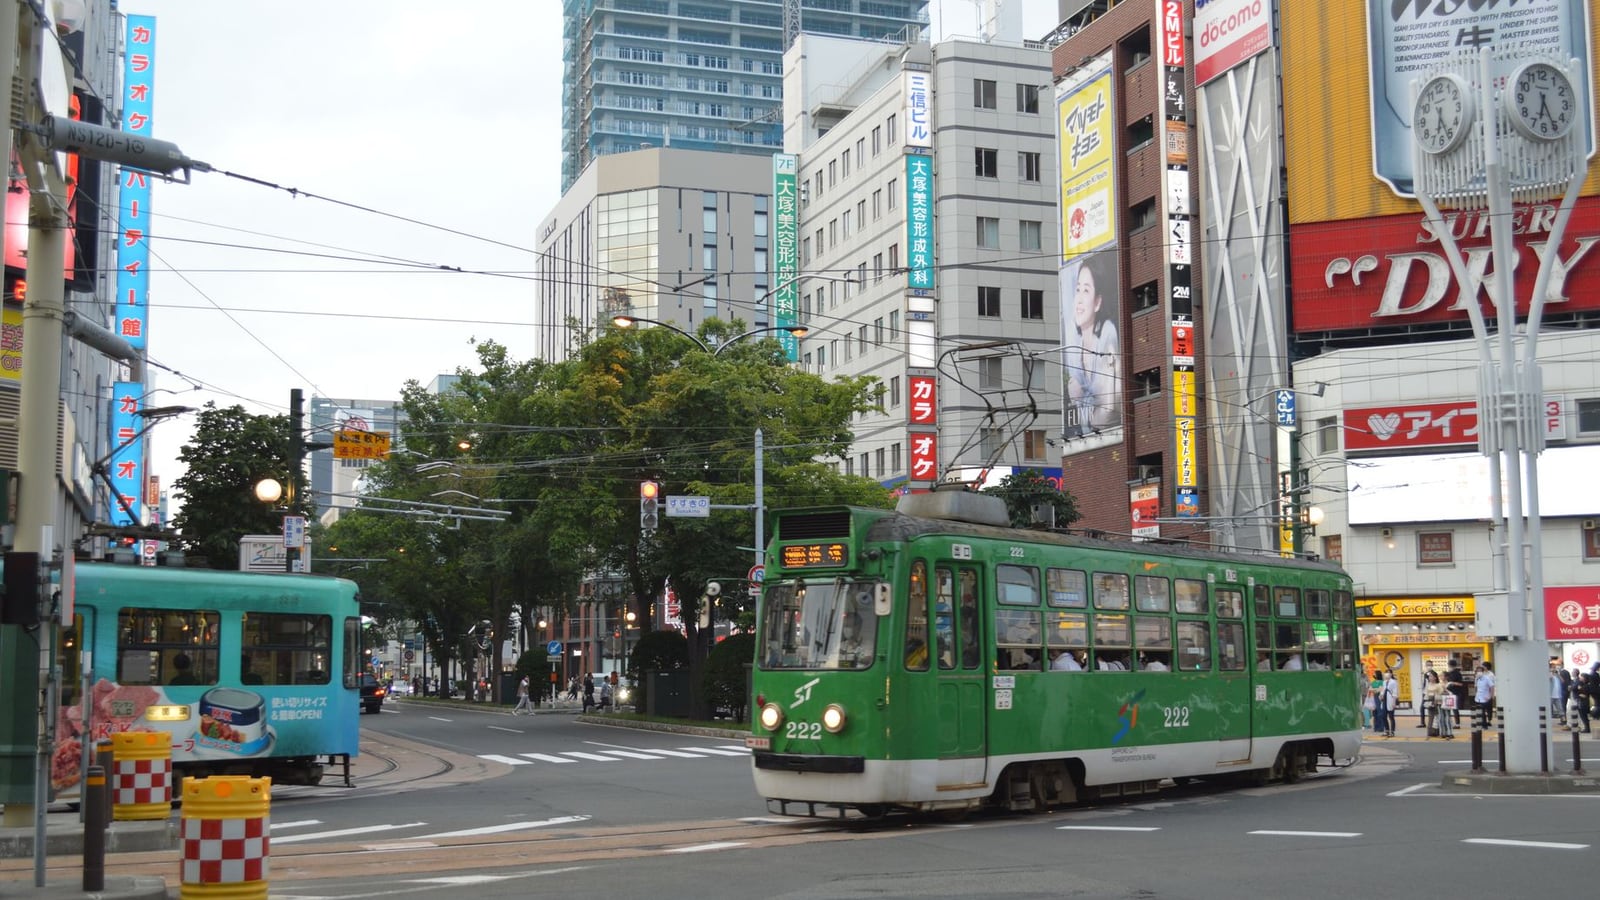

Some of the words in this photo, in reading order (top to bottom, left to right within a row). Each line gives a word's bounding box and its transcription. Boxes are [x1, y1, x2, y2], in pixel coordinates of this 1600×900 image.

[1201, 0, 1261, 48] docomo
[1410, 22, 1427, 31] SUPER
[1428, 21, 1441, 29] DRY
[1450, 16, 1479, 26] BREWED
[1481, 13, 1499, 22] WITH
[1500, 8, 1534, 19] PRECISION
[1499, 20, 1524, 30] UNDER
[1166, 3, 1181, 64] 2Mビル
[1500, 31, 1529, 40] MASTER
[1418, 40, 1449, 50] JAPANESE
[1455, 26, 1495, 55] 生
[1404, 52, 1432, 62] ADVANCED
[131, 27, 151, 130] カラオケ
[1526, 72, 1536, 82] 11
[1537, 70, 1547, 81] 12
[1519, 81, 1530, 92] 10
[1551, 76, 1556, 87] 1
[1434, 83, 1444, 95] 12
[1445, 84, 1451, 94] 1
[1452, 89, 1458, 100] 2
[1558, 86, 1565, 97] 2
[1426, 91, 1435, 101] 11
[1517, 93, 1524, 104] 9
[911, 76, 928, 140] 三信ビル
[1421, 103, 1430, 114] 10
[1455, 102, 1461, 113] 3
[1562, 100, 1569, 111] 3
[1065, 92, 1104, 135] マツモト
[1521, 107, 1528, 118] 8
[1558, 112, 1565, 123] 4
[1420, 118, 1426, 128] 9
[1453, 117, 1459, 128] 4
[1530, 118, 1537, 128] 7
[1541, 122, 1547, 133] 6
[1552, 120, 1558, 131] 5
[1423, 128, 1429, 139] 8
[1447, 128, 1453, 139] 5
[1430, 135, 1436, 146] 7
[1439, 135, 1445, 146] 6
[1071, 131, 1100, 168] キヨシ
[777, 159, 794, 170] 7F
[912, 160, 928, 285] 大塚美容形成外科
[1416, 203, 1558, 244] SUPER
[777, 180, 795, 316] 大塚美容形成外科
[1173, 285, 1190, 299] 2M
[1403, 409, 1478, 440] アイフ
[117, 396, 138, 513] カラオケ
[670, 500, 707, 508] すすきの
[1164, 706, 1190, 728] 222
[786, 721, 822, 740] 222
